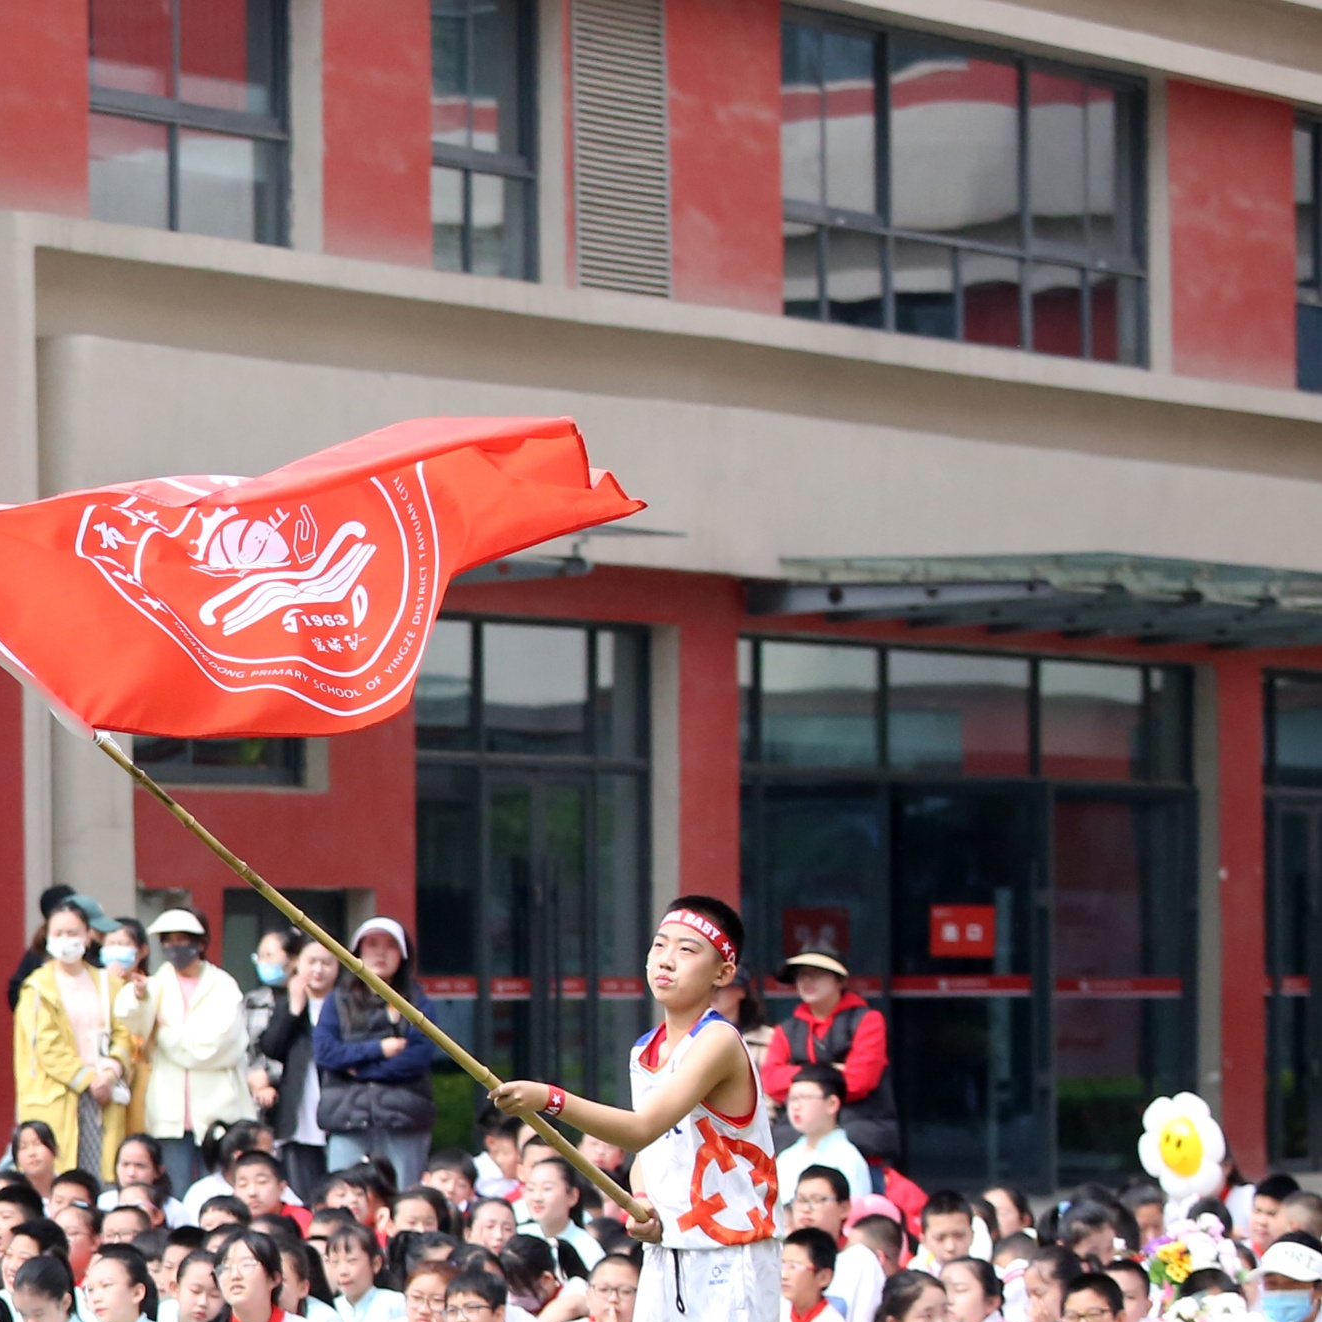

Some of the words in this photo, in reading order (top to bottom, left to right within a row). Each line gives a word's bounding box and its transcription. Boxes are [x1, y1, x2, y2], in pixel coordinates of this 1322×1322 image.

[392, 475, 410, 502] CITY
[405, 502, 426, 560] TAIYUAN
[412, 565, 428, 626] DISTRICT
[301, 614, 349, 628] 1963
[383, 630, 417, 675] YINGZE
[250, 668, 309, 683] PRIMARY
[312, 678, 363, 699] SCHOOL
[365, 675, 383, 691] OF
[682, 911, 721, 941] BABY
